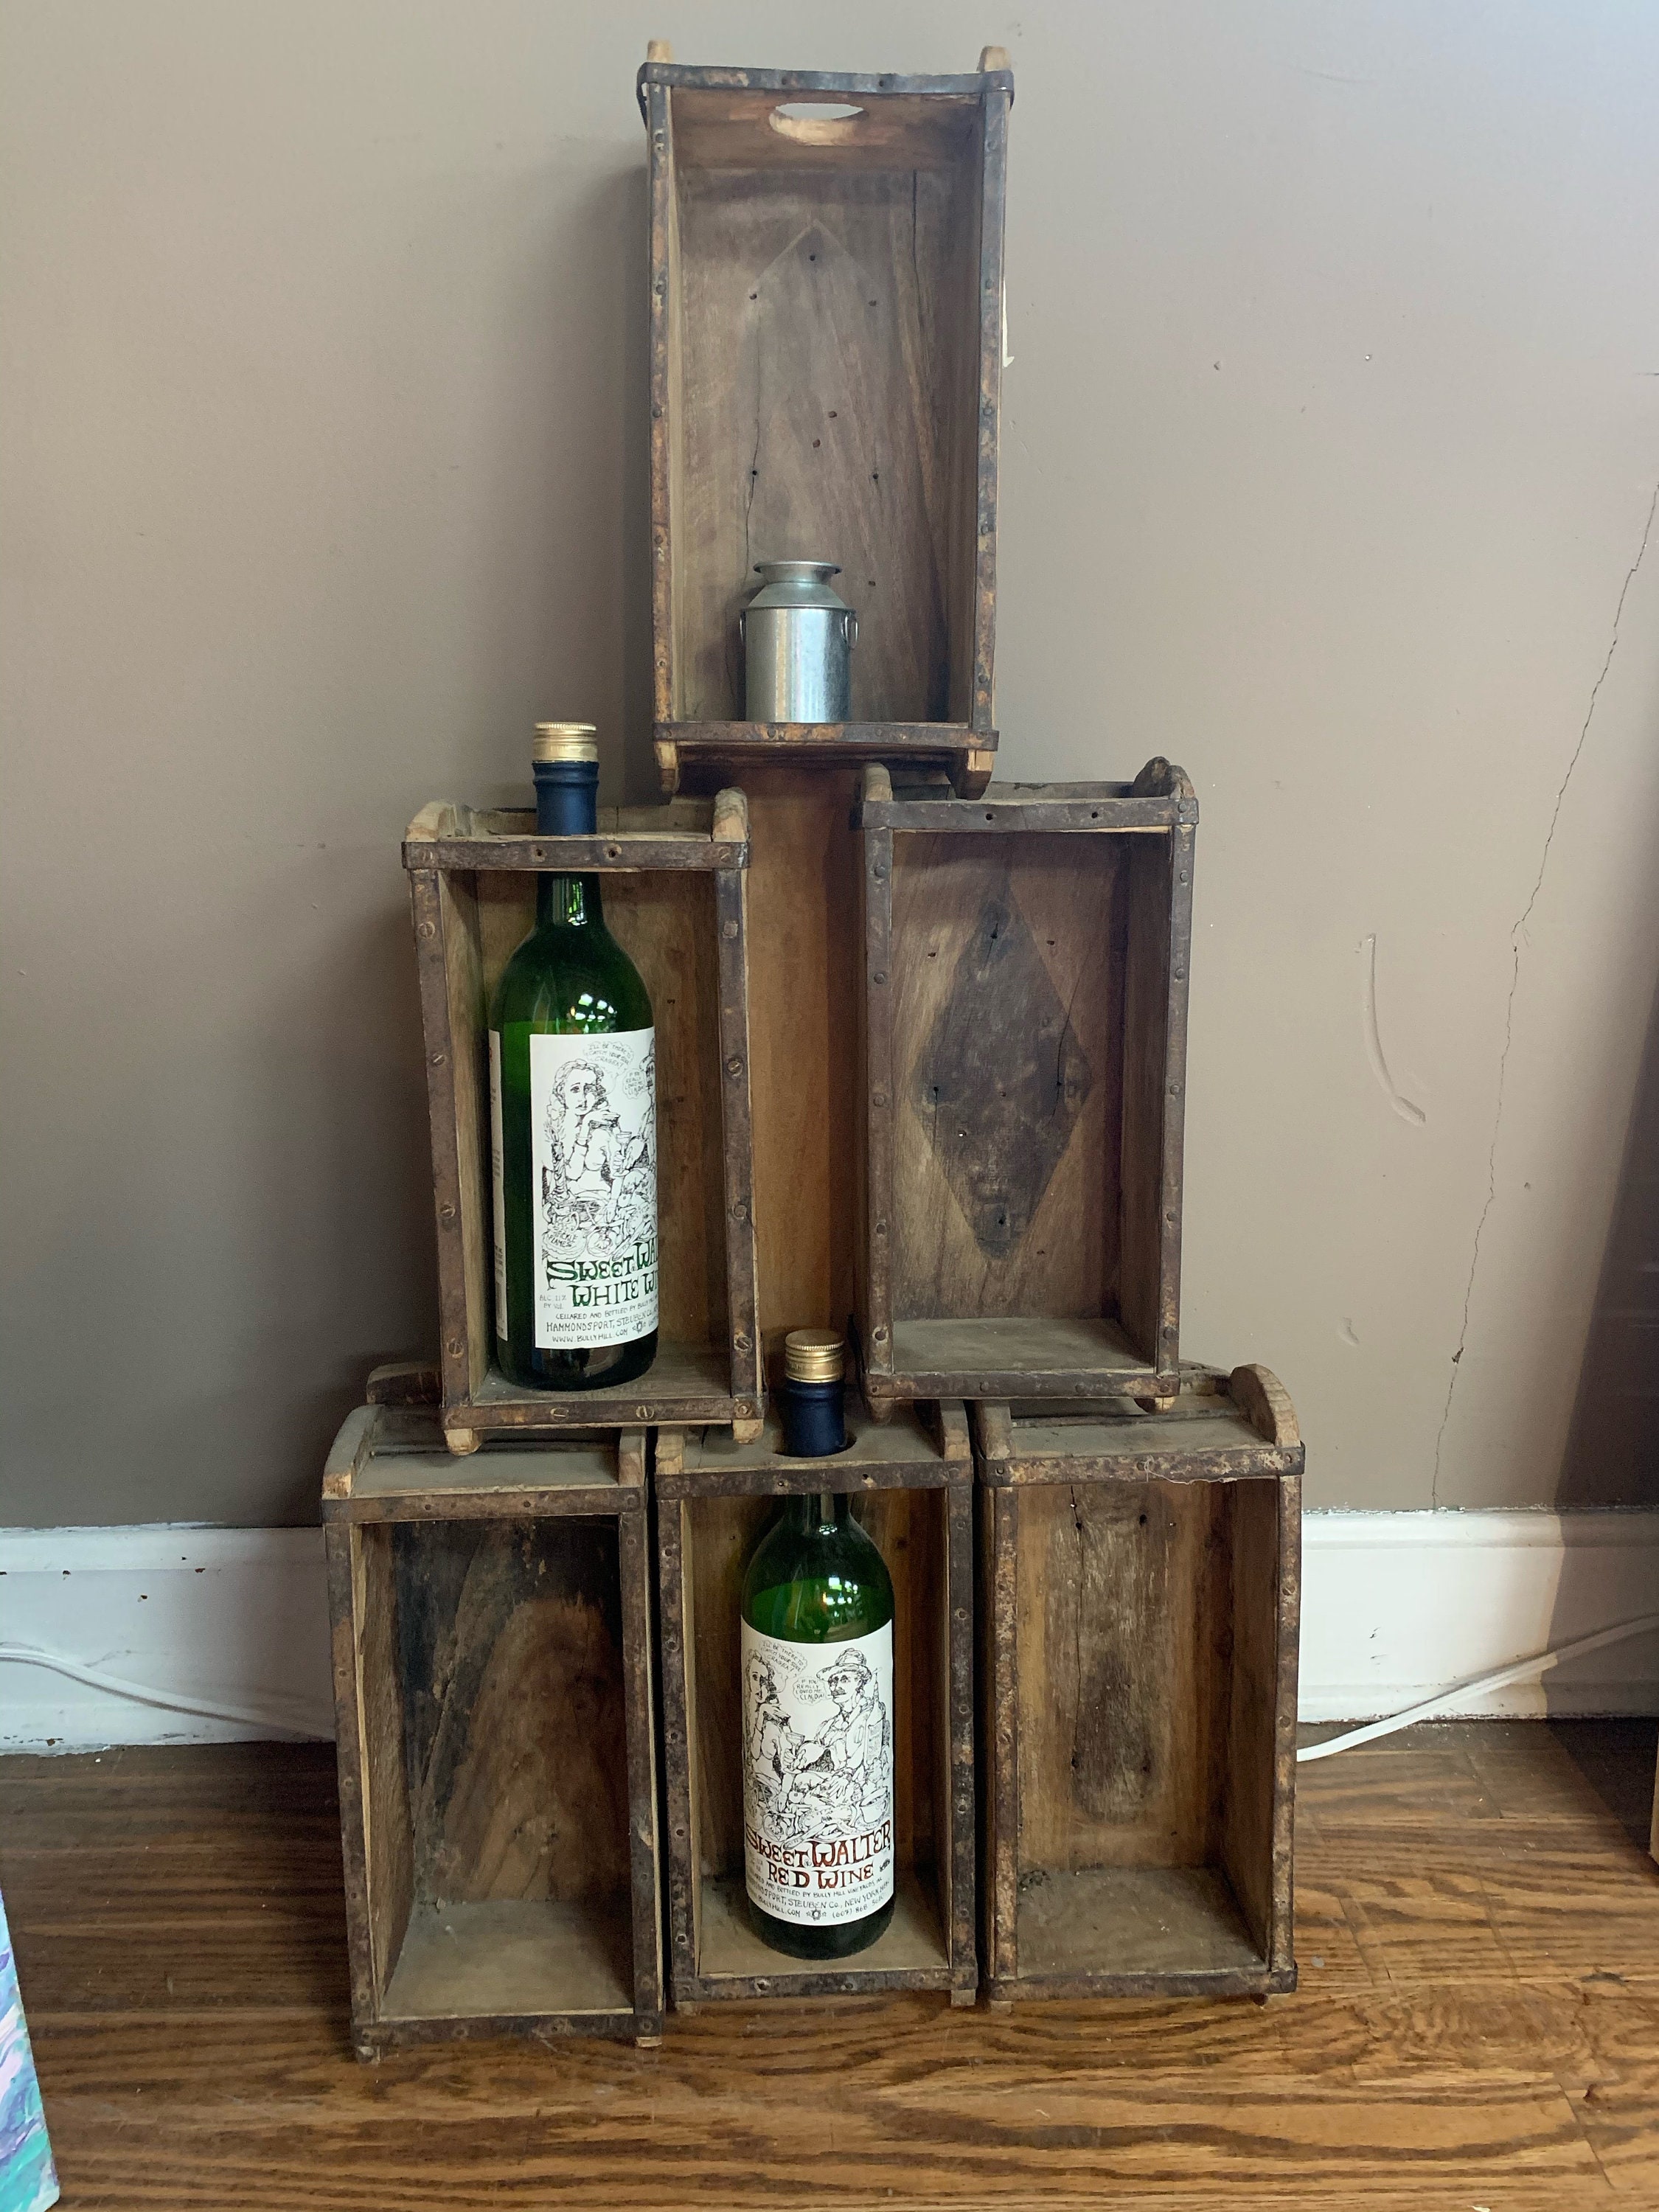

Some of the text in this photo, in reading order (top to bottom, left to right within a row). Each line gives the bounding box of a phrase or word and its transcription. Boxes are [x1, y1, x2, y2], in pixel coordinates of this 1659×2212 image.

[566, 1279, 639, 1307] WHITE
[605, 1307, 628, 1318] BOTTLED
[546, 1320, 615, 1332] HAMMONDSPORT,
[782, 1648, 798, 1660] THERE
[745, 1825, 810, 1868] SWEET
[804, 1819, 891, 1867] WALTER
[767, 1860, 810, 1888] RED
[813, 1861, 875, 1889] WINE
[777, 1885, 801, 1896] BOTTLED
[787, 1899, 827, 1910] STEUBEN
[844, 1896, 861, 1907] NEW
